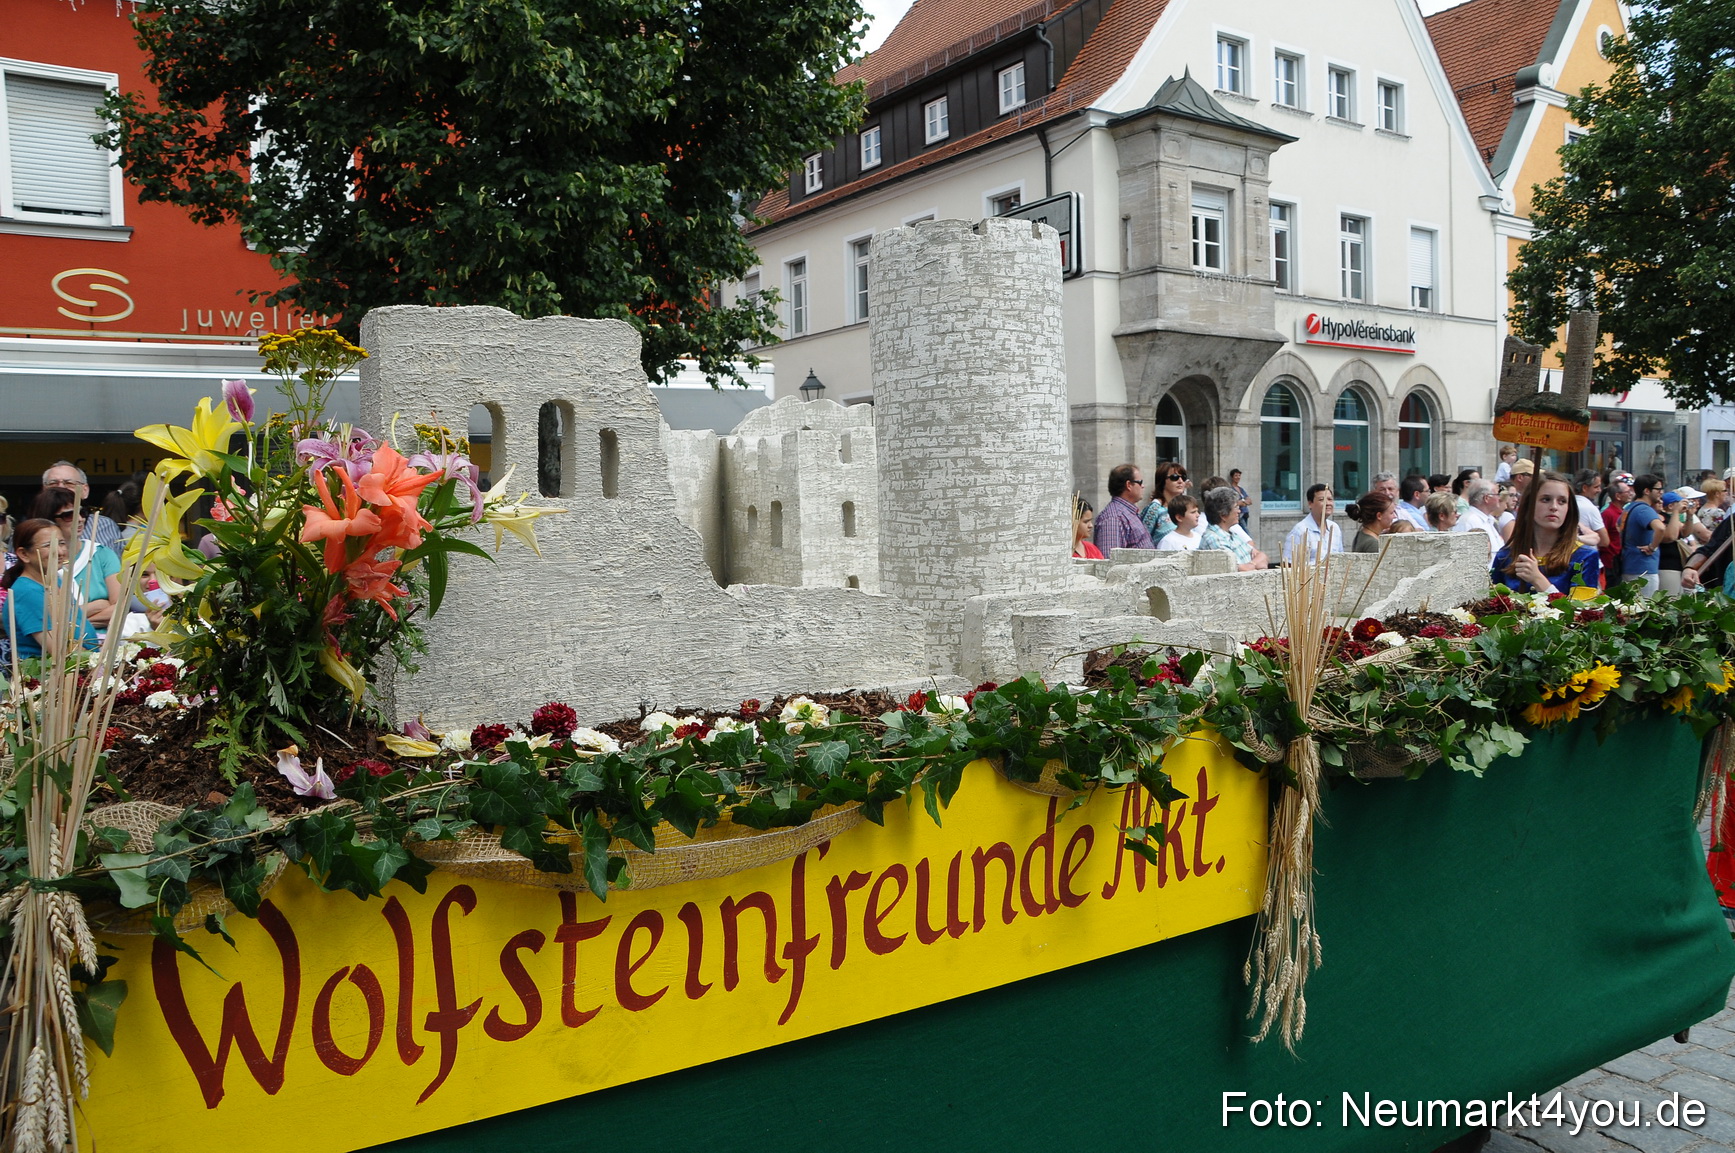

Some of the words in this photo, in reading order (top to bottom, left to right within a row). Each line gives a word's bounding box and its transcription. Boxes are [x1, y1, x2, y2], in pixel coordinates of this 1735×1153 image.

[180, 306, 329, 332] juwelier
[1321, 316, 1416, 343] HypoVereinsbank
[151, 796, 1095, 1109] Wolfsteinfreunde
